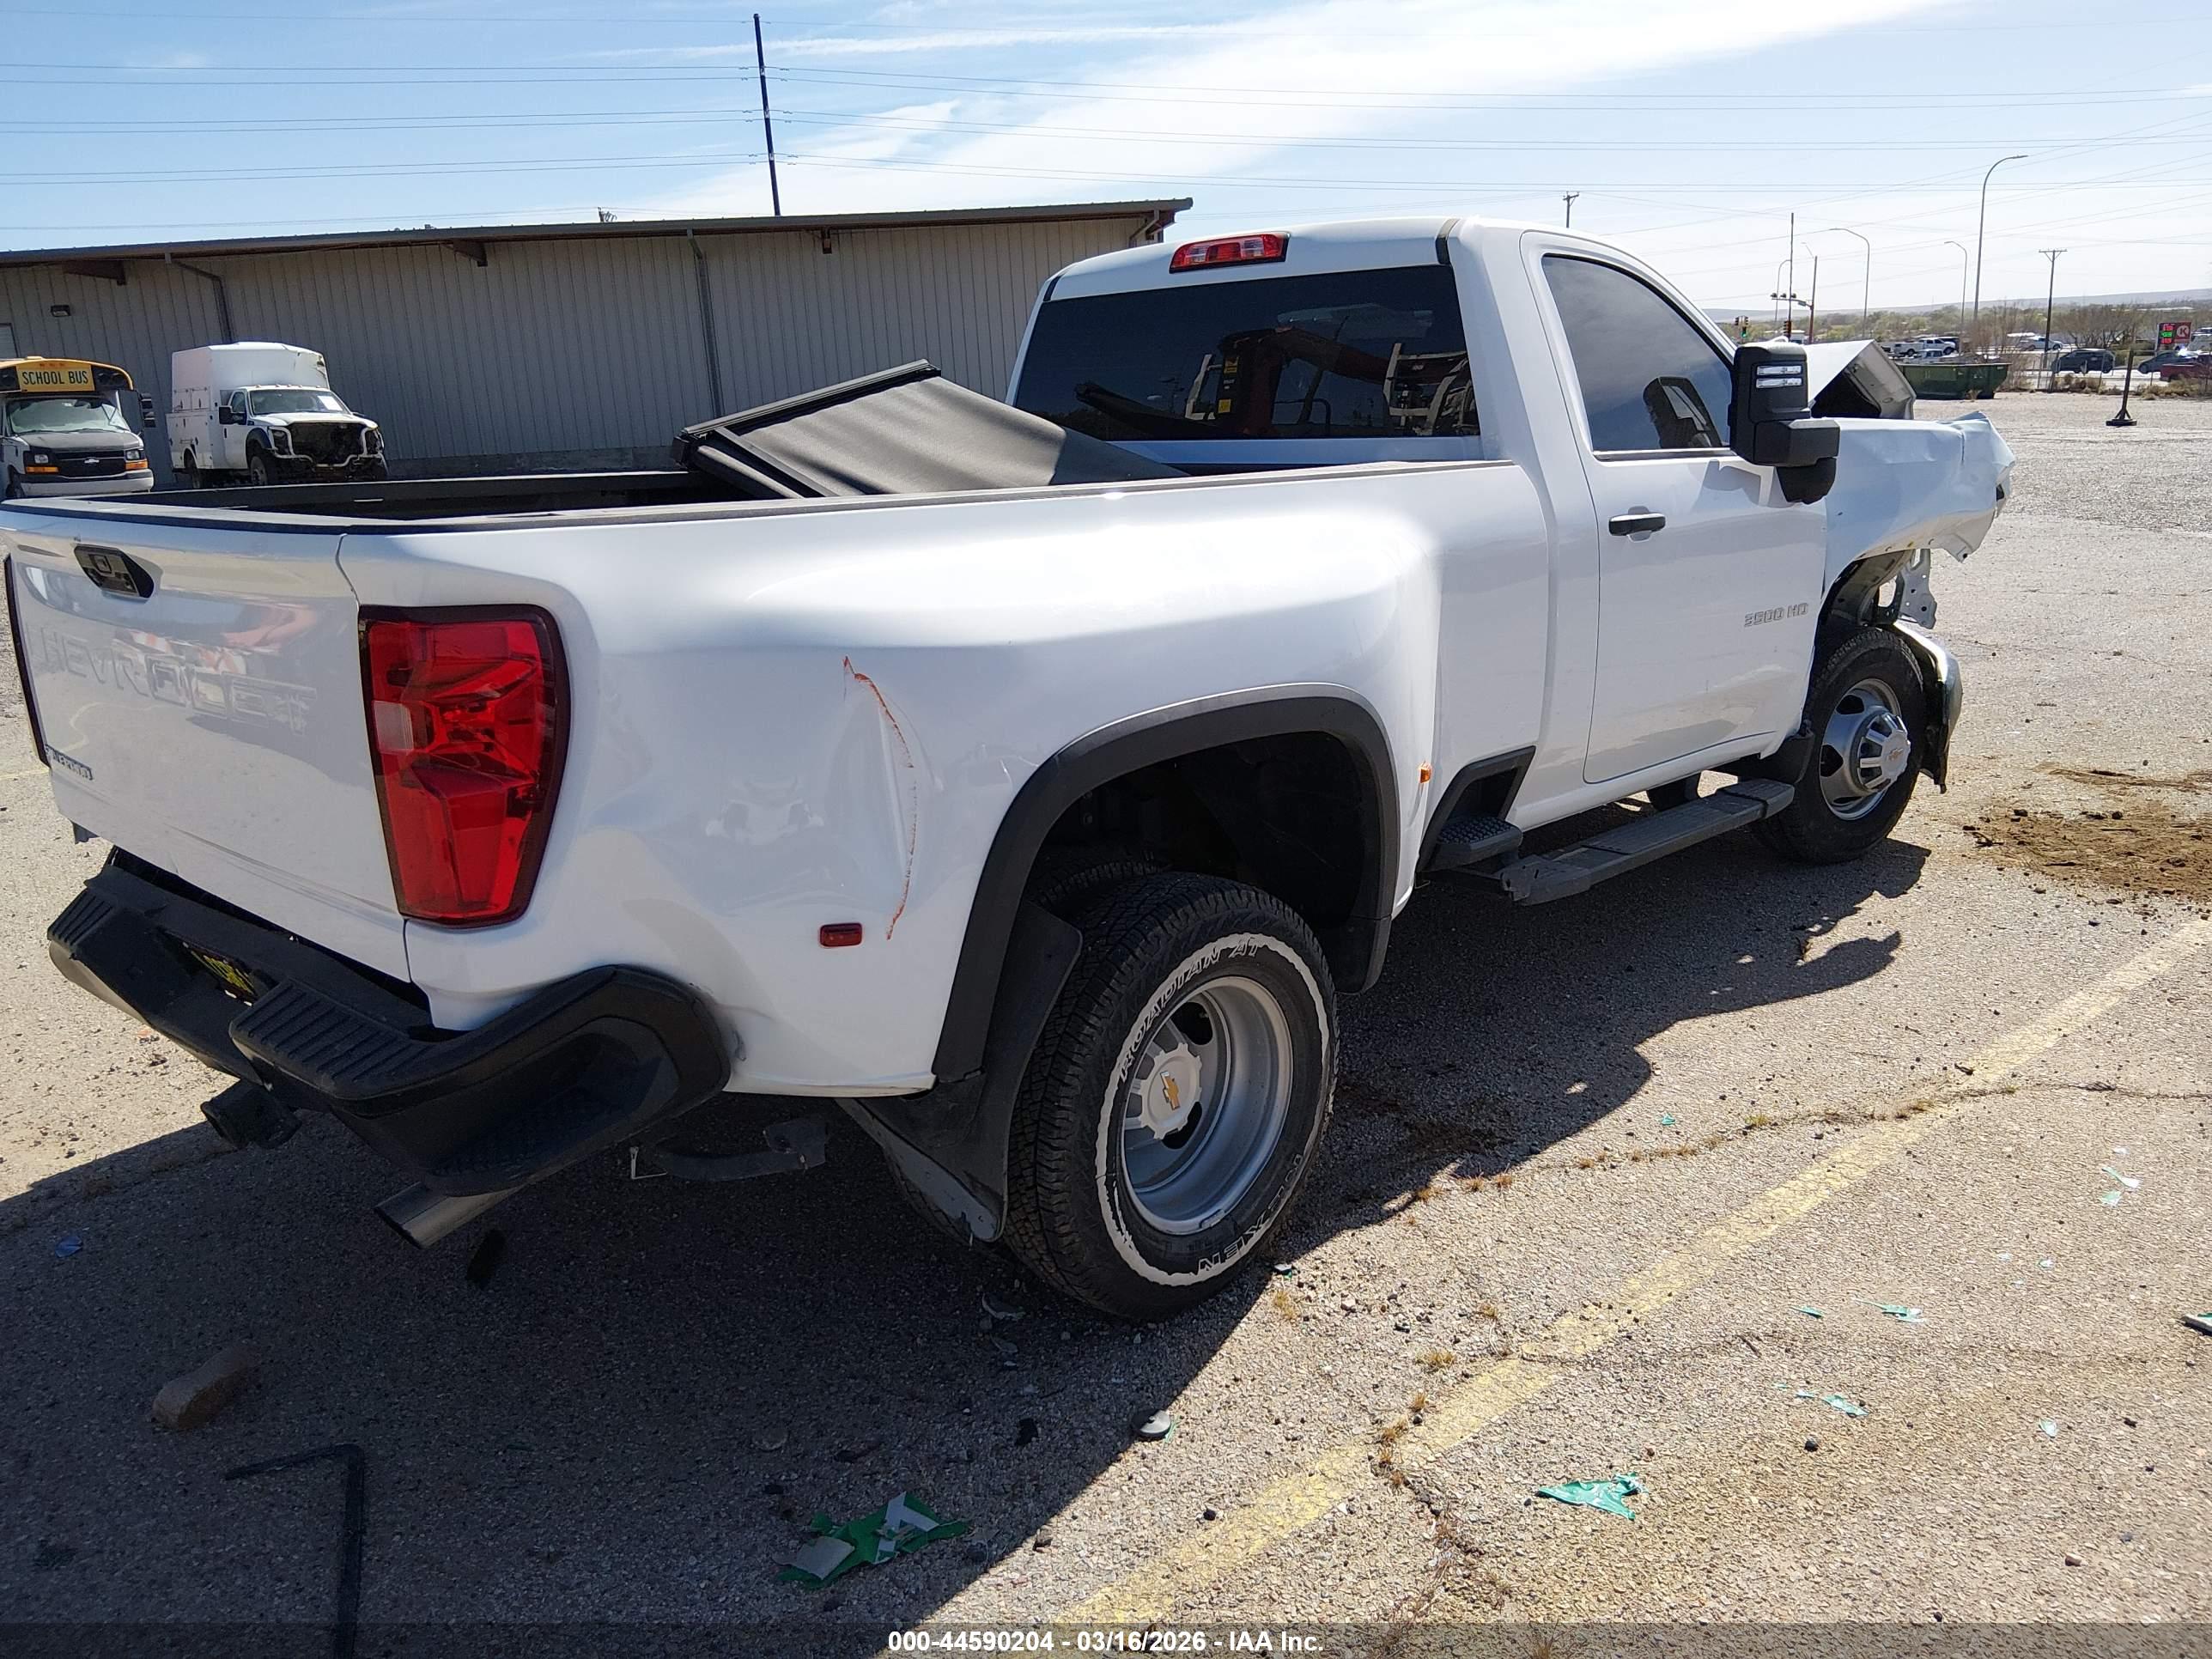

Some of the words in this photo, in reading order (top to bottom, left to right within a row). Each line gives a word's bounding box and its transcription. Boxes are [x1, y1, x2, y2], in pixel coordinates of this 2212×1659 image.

[22, 371, 65, 385] SCHOOL
[68, 371, 88, 384] BUS
[1787, 602, 1809, 618] HD
